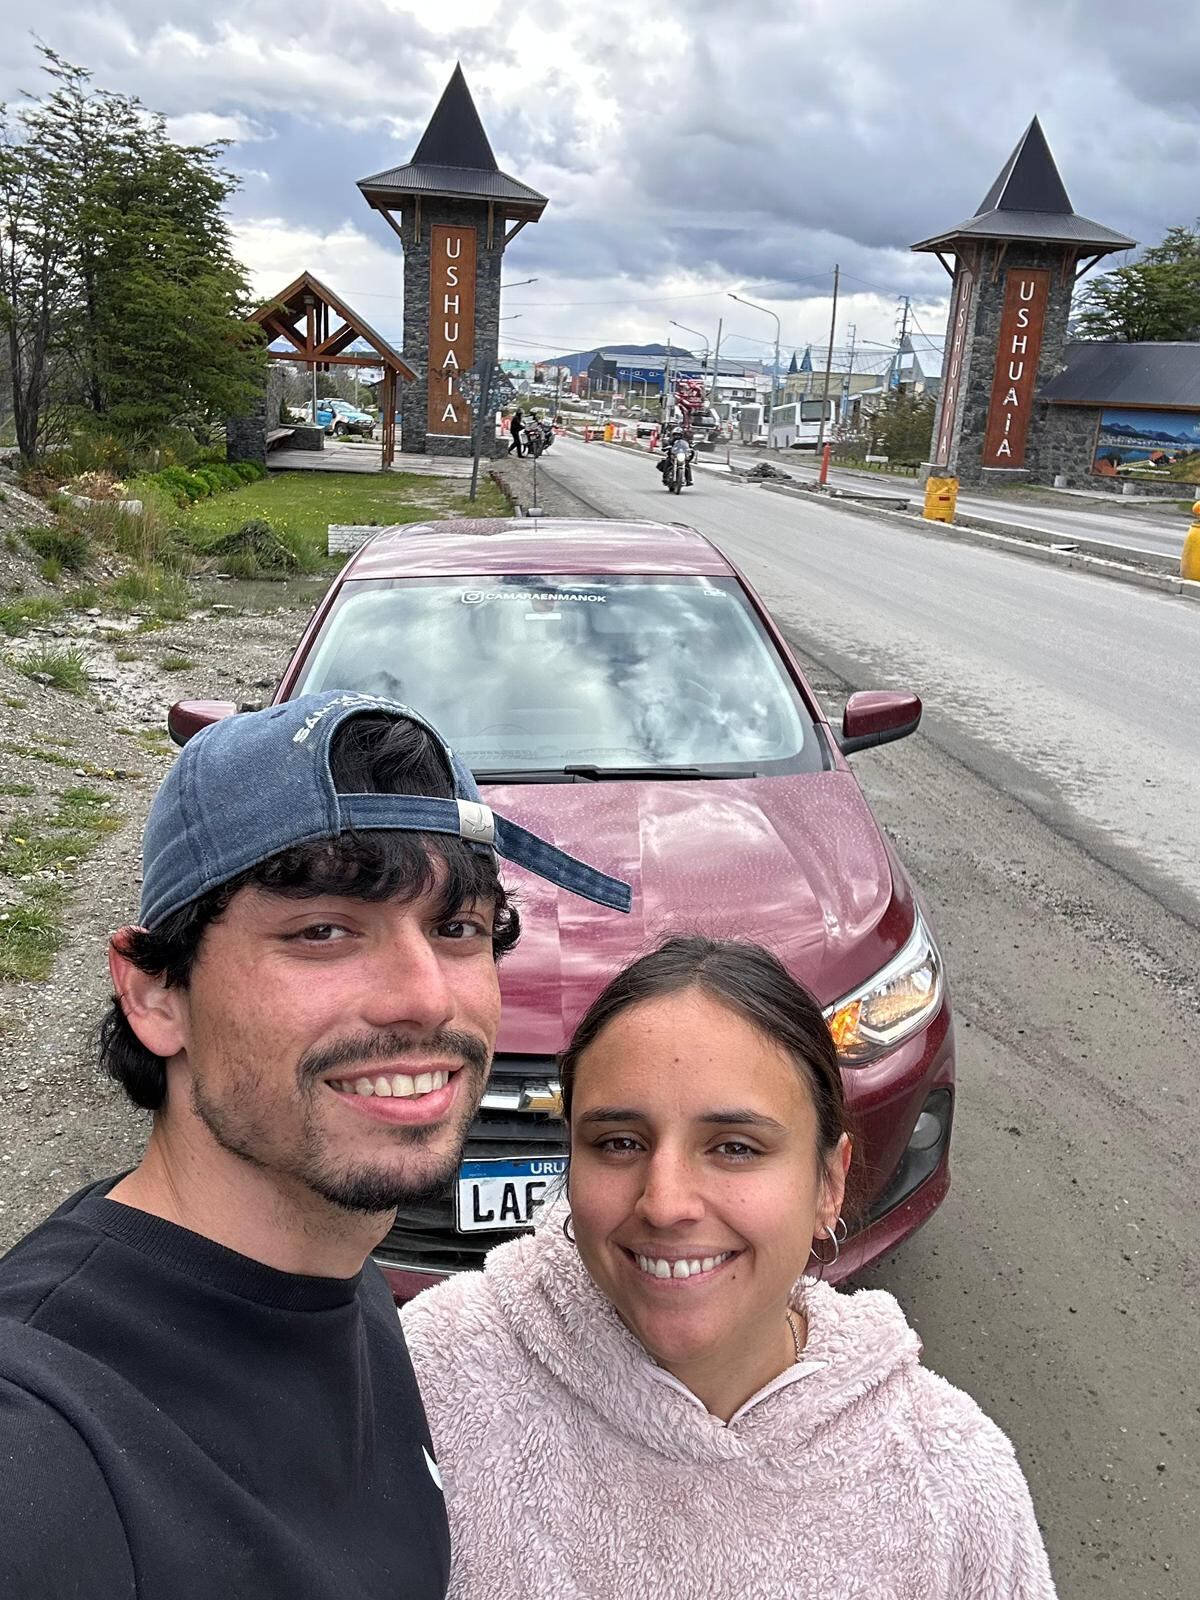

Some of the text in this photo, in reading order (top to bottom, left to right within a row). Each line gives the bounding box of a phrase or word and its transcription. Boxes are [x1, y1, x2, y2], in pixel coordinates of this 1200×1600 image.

[441, 237, 461, 423] USHUAIA
[940, 282, 969, 454] USHUAIA
[996, 280, 1035, 458] USHUAIA
[486, 593, 607, 602] CAMARAENMANOK
[473, 1181, 547, 1223] LAF
[530, 1162, 565, 1174] URU
